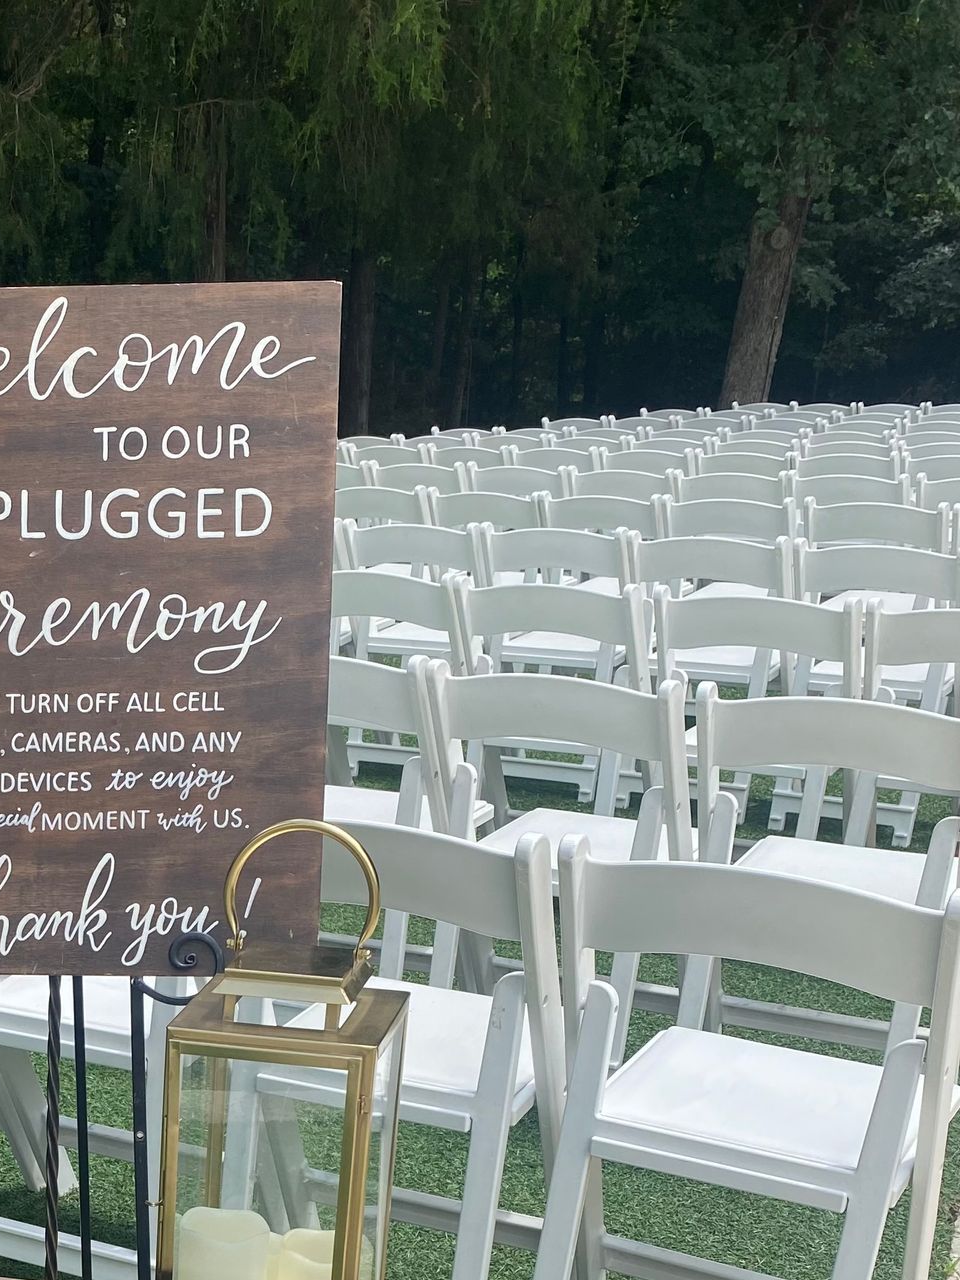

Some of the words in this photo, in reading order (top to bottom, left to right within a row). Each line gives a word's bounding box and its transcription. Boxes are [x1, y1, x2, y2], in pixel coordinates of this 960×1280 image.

[93, 426, 147, 461] TO
[161, 424, 249, 460] OUR
[6, 693, 68, 715] TURN
[76, 693, 120, 714] OFF
[126, 692, 166, 713] ALL
[172, 692, 224, 712] CELL
[11, 732, 130, 755] CAMERAS,
[135, 731, 185, 753] AND
[191, 731, 242, 753] ANY
[0, 772, 91, 792] DEVICES
[105, 770, 143, 791] to
[150, 763, 234, 800] enjoy
[41, 809, 150, 831] MOMENT
[156, 804, 207, 834] with
[213, 809, 249, 830] US.
